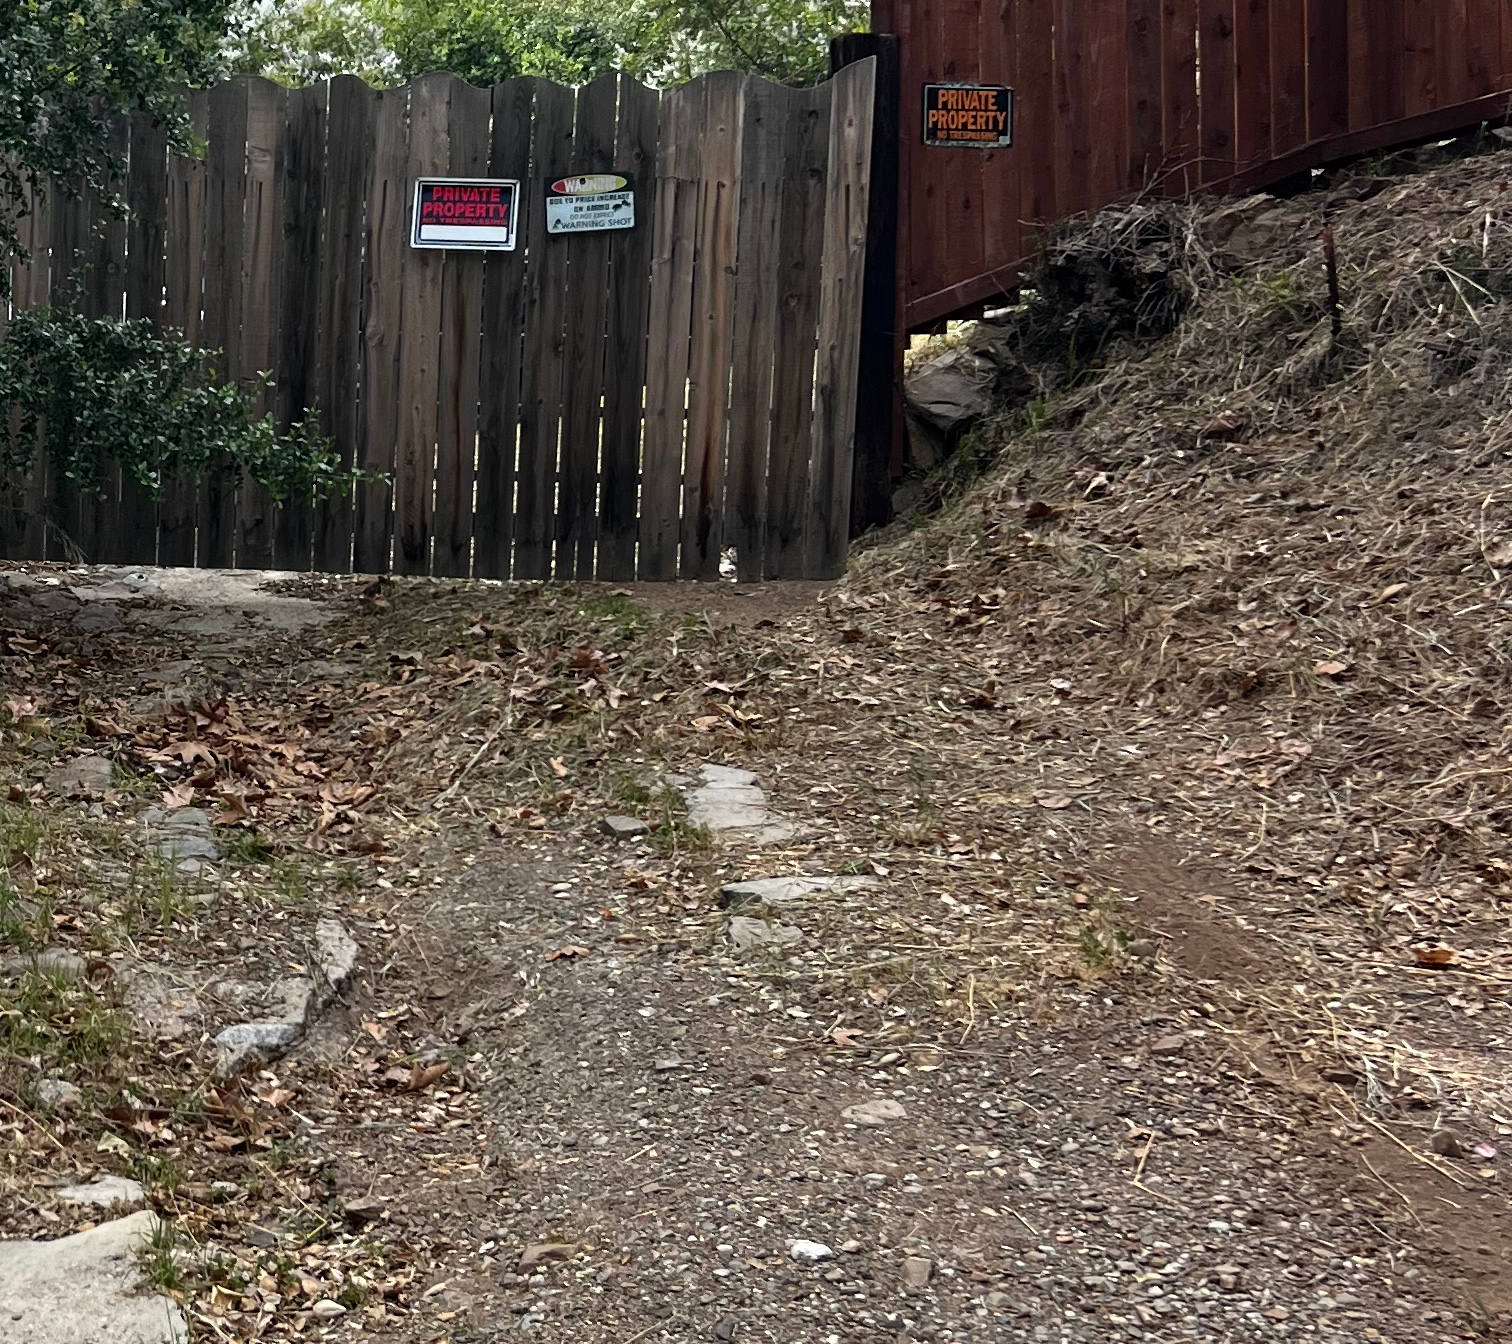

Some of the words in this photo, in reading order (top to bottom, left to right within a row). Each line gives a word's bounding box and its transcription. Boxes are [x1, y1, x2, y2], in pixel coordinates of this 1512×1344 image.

[937, 89, 998, 110] PRIVATE
[928, 110, 1006, 130] PROPERTY
[432, 186, 501, 202] PRIVATE
[422, 202, 508, 218] PROPERTY
[561, 219, 606, 229] WARNING
[608, 217, 632, 226] SHOT
